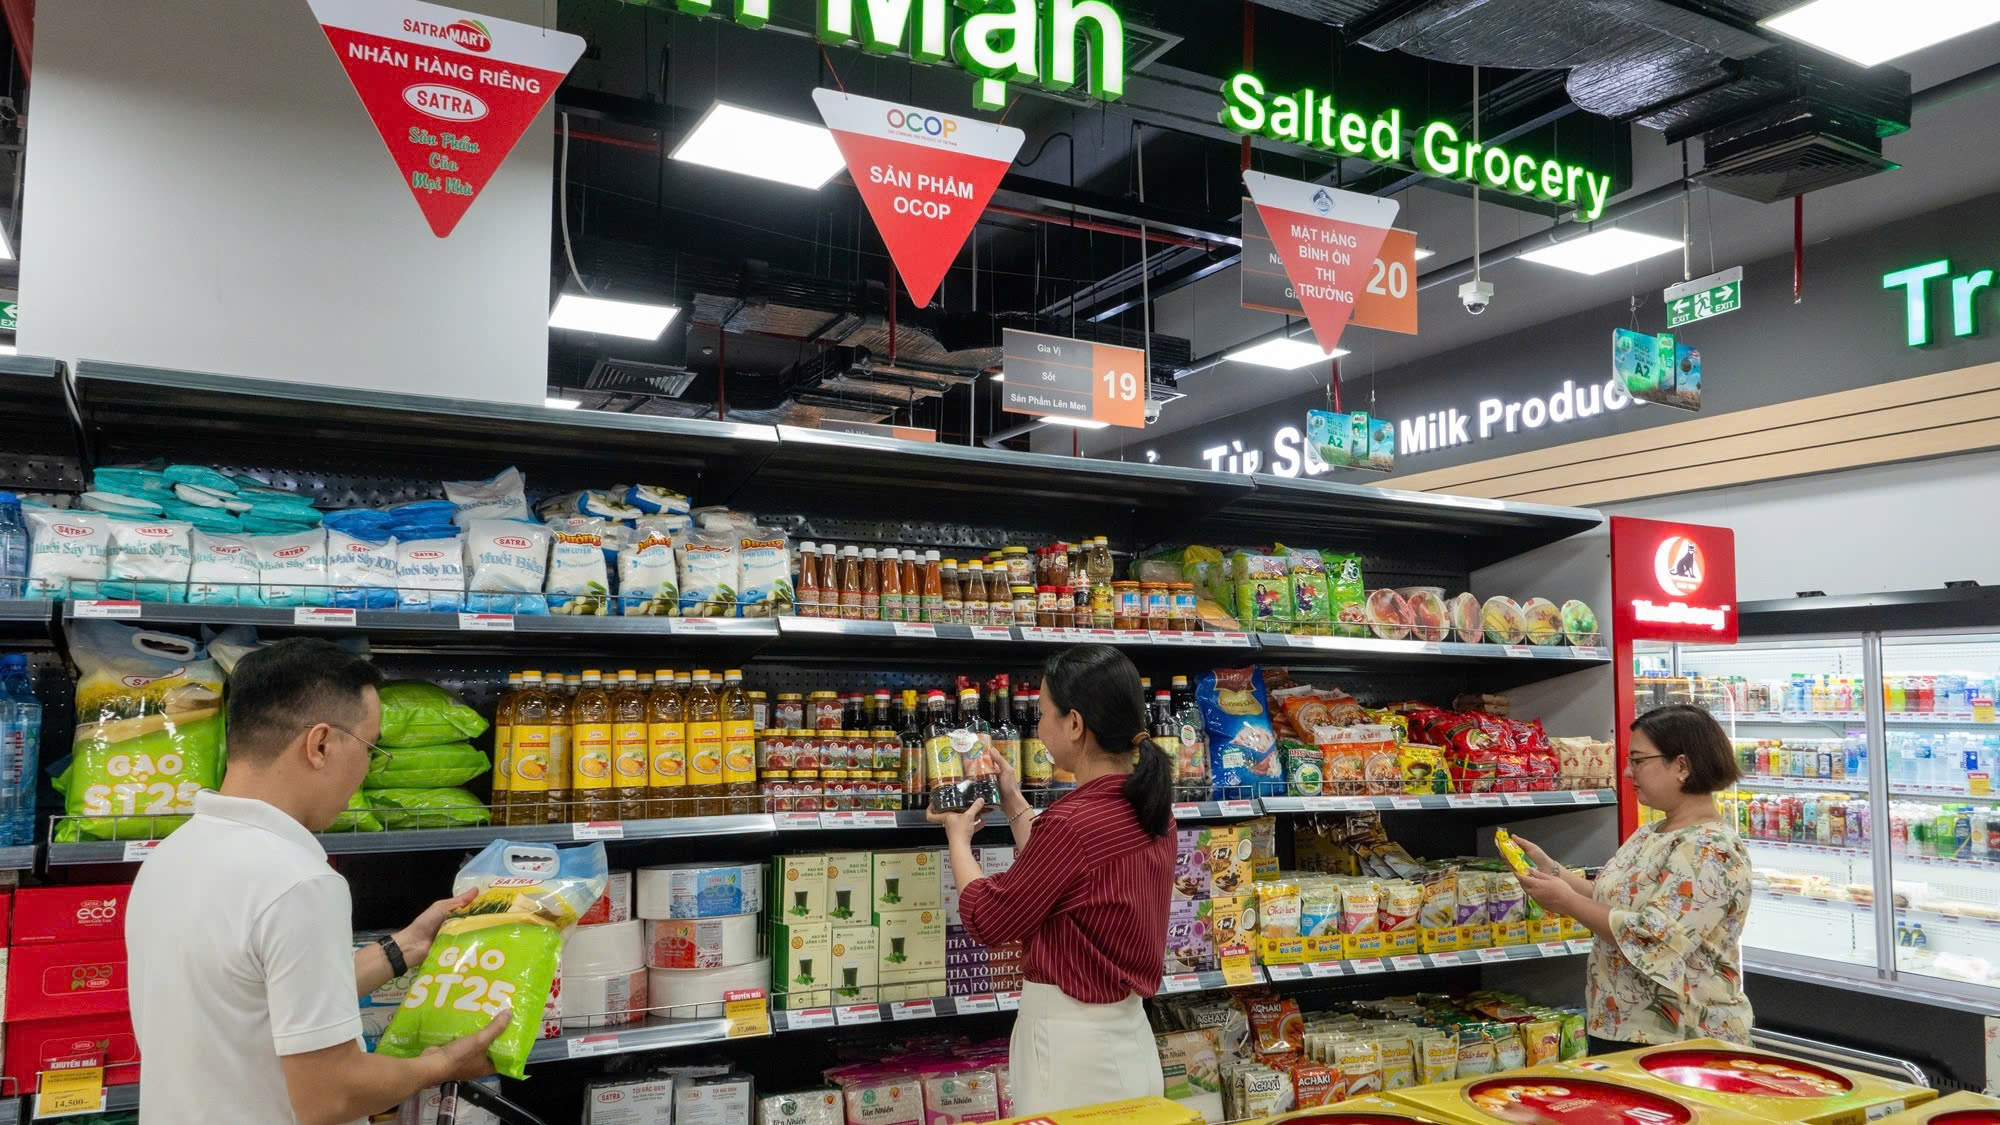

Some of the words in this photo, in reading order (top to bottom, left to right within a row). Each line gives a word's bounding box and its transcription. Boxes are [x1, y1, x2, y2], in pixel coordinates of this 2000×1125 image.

[349, 43, 408, 69] NHÃN
[415, 56, 474, 80] HÀNG
[480, 69, 541, 94] RIÊNG
[417, 90, 474, 115] SATRA
[887, 108, 957, 139] OCOP
[409, 126, 437, 146] Sản
[1224, 72, 1402, 162] Salted
[1416, 121, 1610, 222] Grocery
[429, 153, 458, 171] Của
[413, 172, 440, 194] Mọi
[445, 178, 473, 195] Nhà
[869, 165, 911, 189] SẢN
[918, 175, 974, 200] PHẨM
[893, 196, 951, 220] OCOP
[1321, 229, 1357, 248] HÀNG
[1299, 245, 1329, 262] BÌNH
[1316, 267, 1336, 285] THỊ
[1366, 258, 1408, 299] 20
[1299, 283, 1354, 304] TRƯỜNG
[1715, 300, 1734, 312] EXIT
[1672, 313, 1690, 325] EXIT
[1037, 344, 1051, 354] Gia
[1052, 346, 1061, 357] Vị
[1635, 362, 1651, 379] A2
[1103, 370, 1137, 401] 19
[1011, 393, 1026, 403] Sản
[1053, 397, 1068, 408] Lên
[1070, 401, 1087, 411] Men
[1400, 408, 1472, 455] Milk
[1479, 380, 1646, 438] Produc
[1328, 435, 1344, 448] A2
[58, 525, 87, 536] SATRA
[499, 538, 526, 546] SATRA
[279, 547, 305, 557] SATRA
[107, 753, 184, 782] GẠO
[82, 781, 200, 817] ST25
[495, 877, 534, 886] SATRA
[77, 906, 116, 920] eco
[947, 937, 968, 949] TÍA
[437, 946, 506, 973] GẠO
[947, 951, 969, 964] TÍA
[971, 950, 989, 962] TÔ
[989, 949, 1013, 961] DIẾP
[947, 966, 969, 978] TÍA
[971, 965, 989, 978] TÔ
[404, 973, 516, 1018] ST25
[948, 981, 969, 994] TÍA
[972, 980, 989, 992] TÔ
[1251, 1003, 1282, 1013] ACHAKI
[1196, 1011, 1230, 1025] ACHAKI
[1248, 1079, 1280, 1093] ACHAKI
[1298, 1073, 1331, 1087] ACHAKI
[601, 1093, 621, 1102] SATRA
